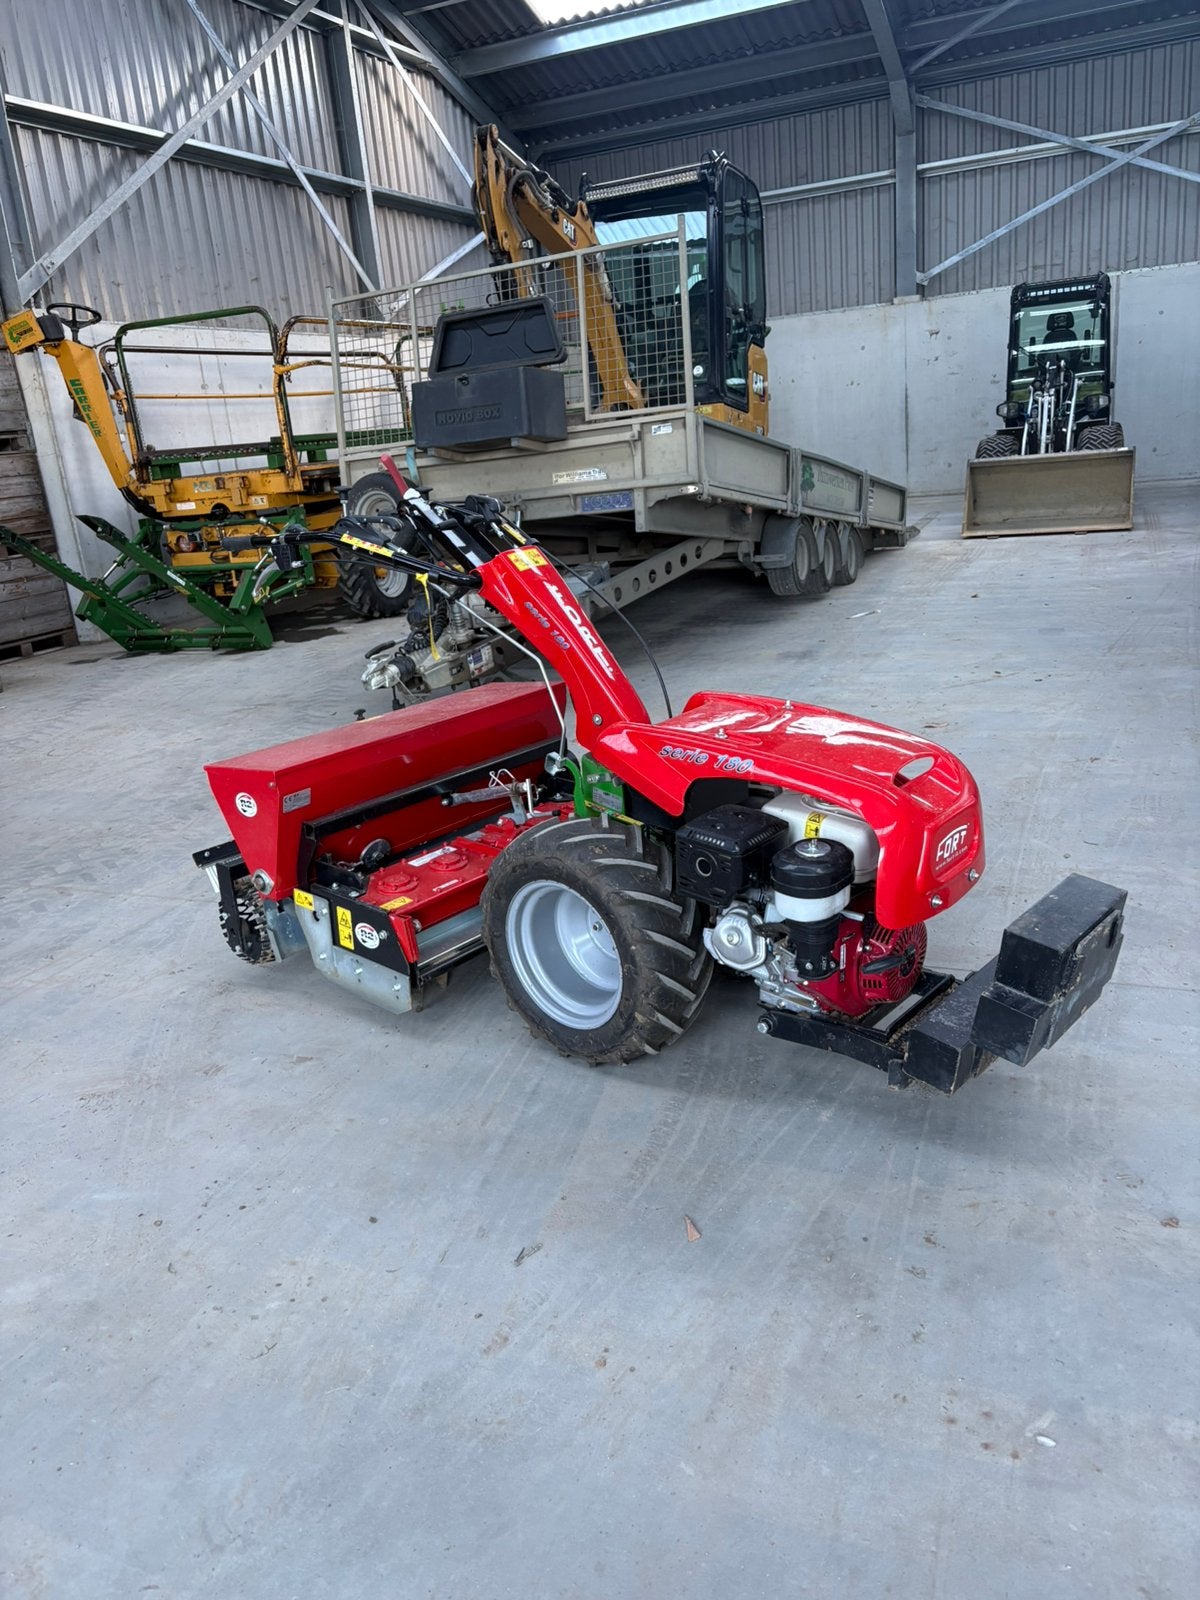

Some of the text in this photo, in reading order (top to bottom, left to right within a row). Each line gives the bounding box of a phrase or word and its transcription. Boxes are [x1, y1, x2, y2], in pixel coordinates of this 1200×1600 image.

[562, 217, 575, 241] CAT
[752, 371, 764, 396] CAT
[660, 745, 755, 774] serie 180
[935, 824, 969, 862] FORT
